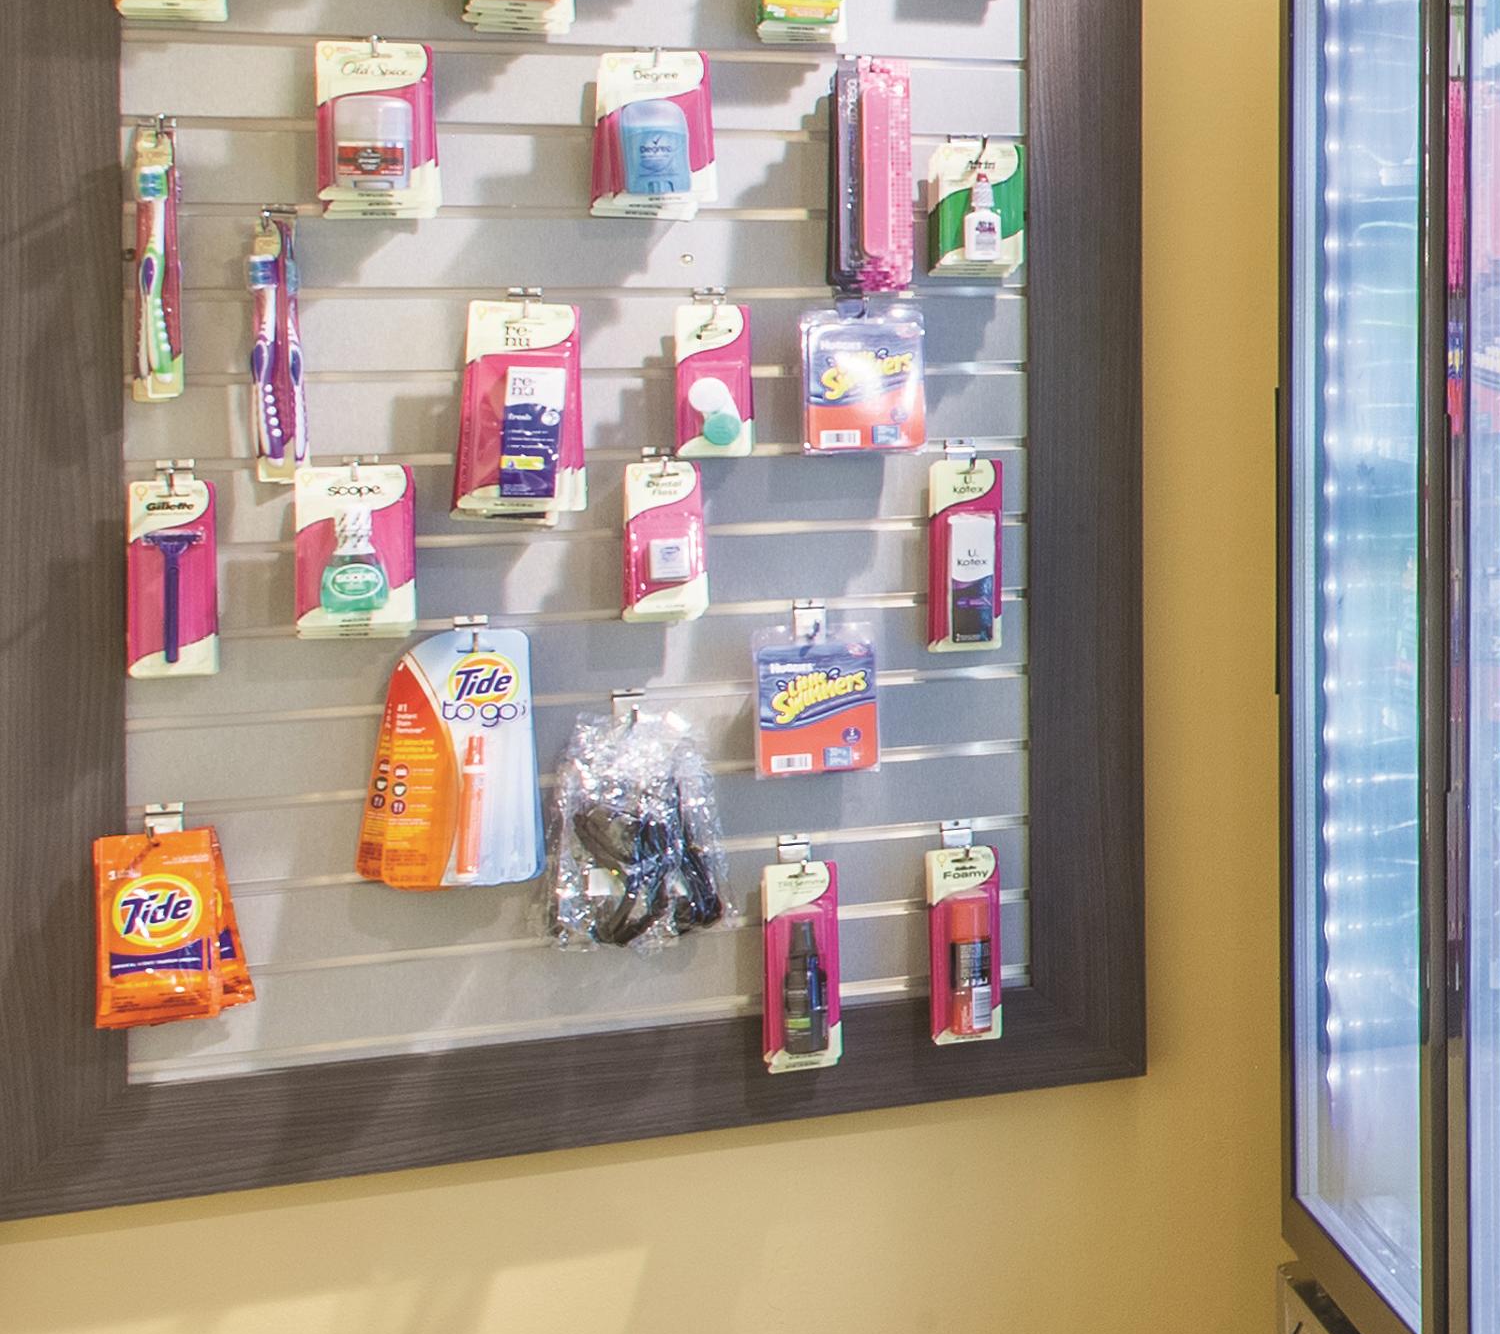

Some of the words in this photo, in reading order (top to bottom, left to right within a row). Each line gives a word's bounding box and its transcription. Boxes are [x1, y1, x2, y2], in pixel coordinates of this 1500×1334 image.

[633, 67, 680, 84] Degree
[505, 336, 531, 348] nu
[328, 484, 381, 498] scope
[146, 502, 195, 511] Gillette
[957, 557, 987, 566] Kotex
[455, 667, 512, 701] Tide
[442, 702, 475, 720] to
[480, 703, 518, 727] go
[943, 869, 988, 880] Foamy
[121, 889, 192, 935] Tide
